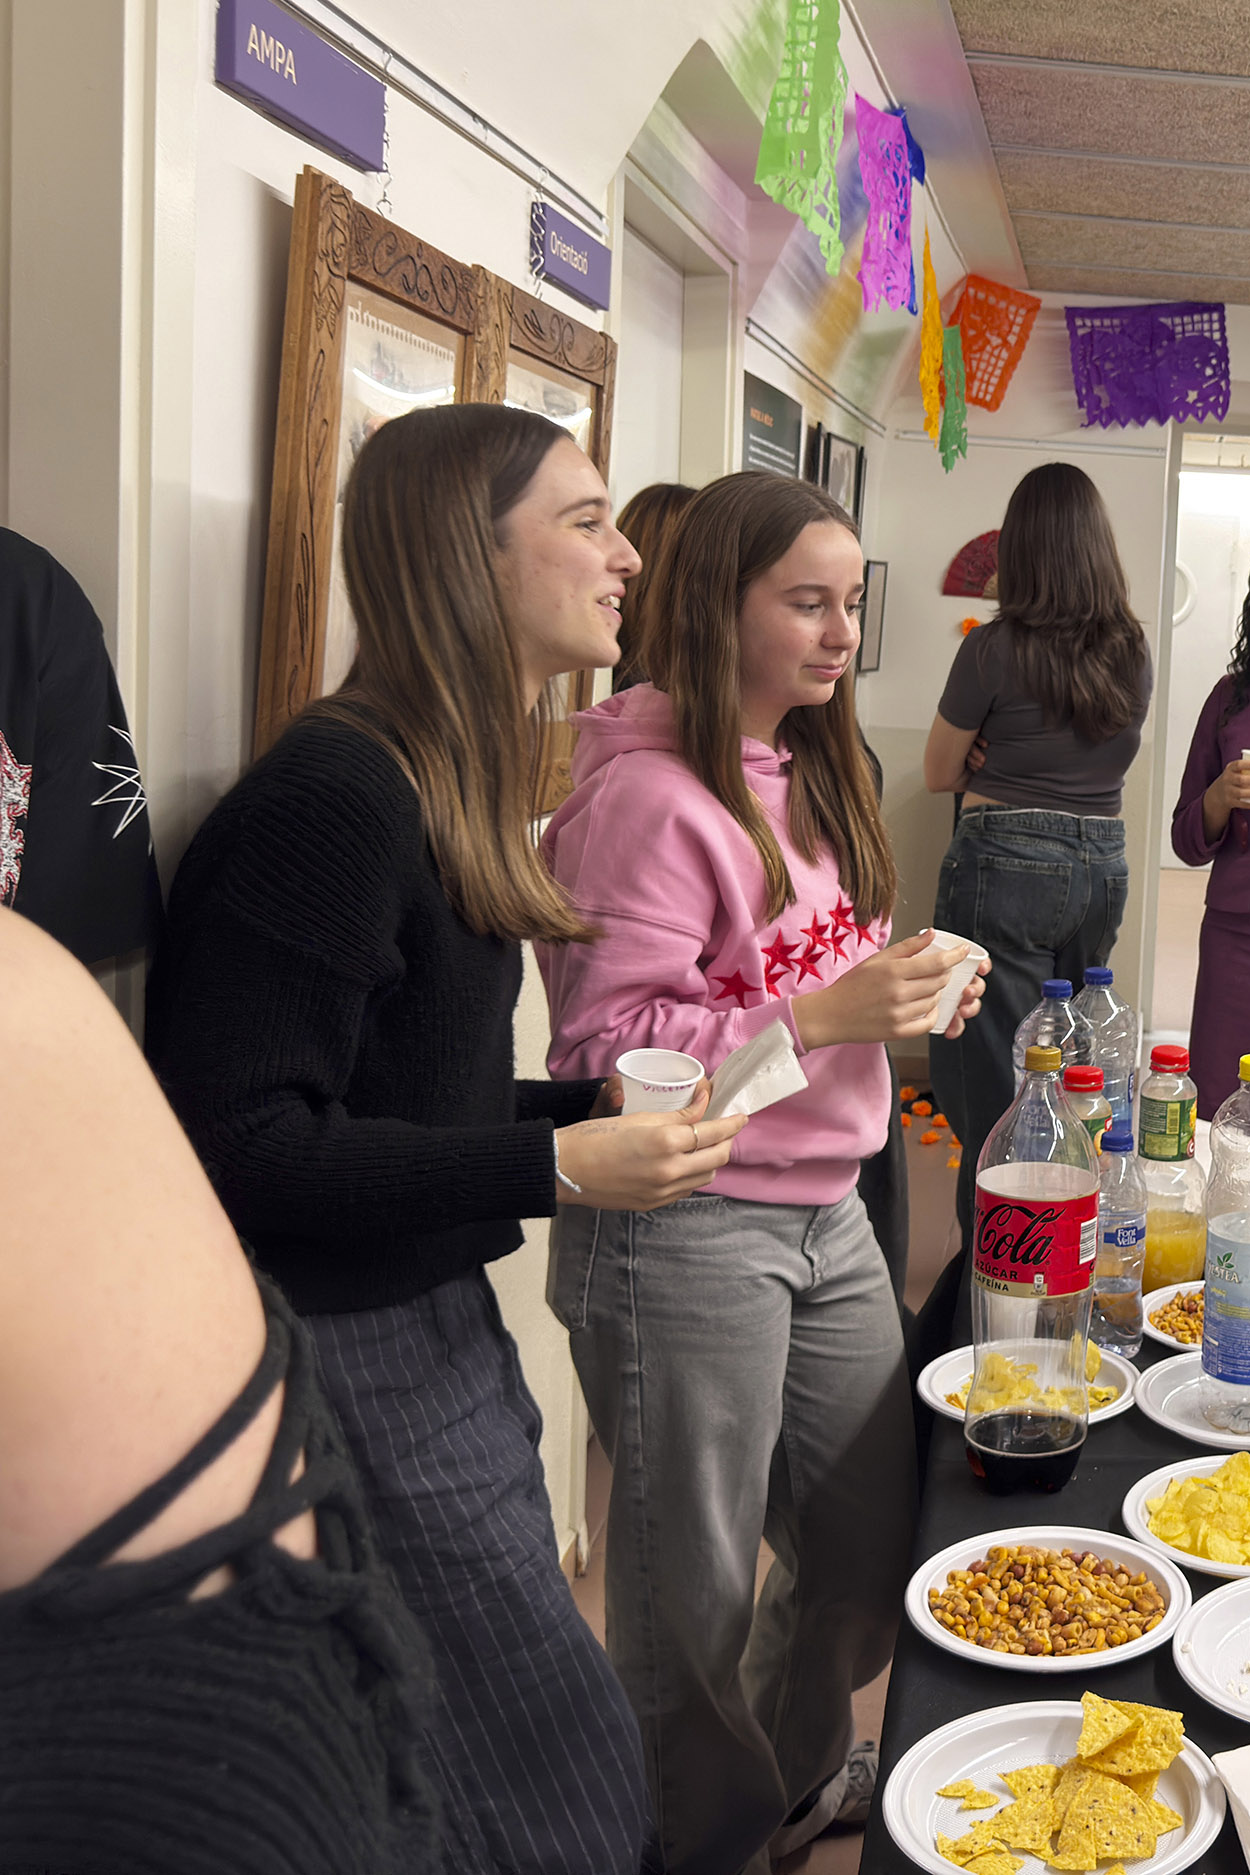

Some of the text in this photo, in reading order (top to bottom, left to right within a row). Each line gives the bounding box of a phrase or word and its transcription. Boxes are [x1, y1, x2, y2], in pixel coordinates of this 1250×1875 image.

[247, 23, 297, 86] AMPA
[551, 231, 588, 275] Orientació
[1117, 1236, 1136, 1246] Vella
[1118, 1229, 1136, 1238] Font
